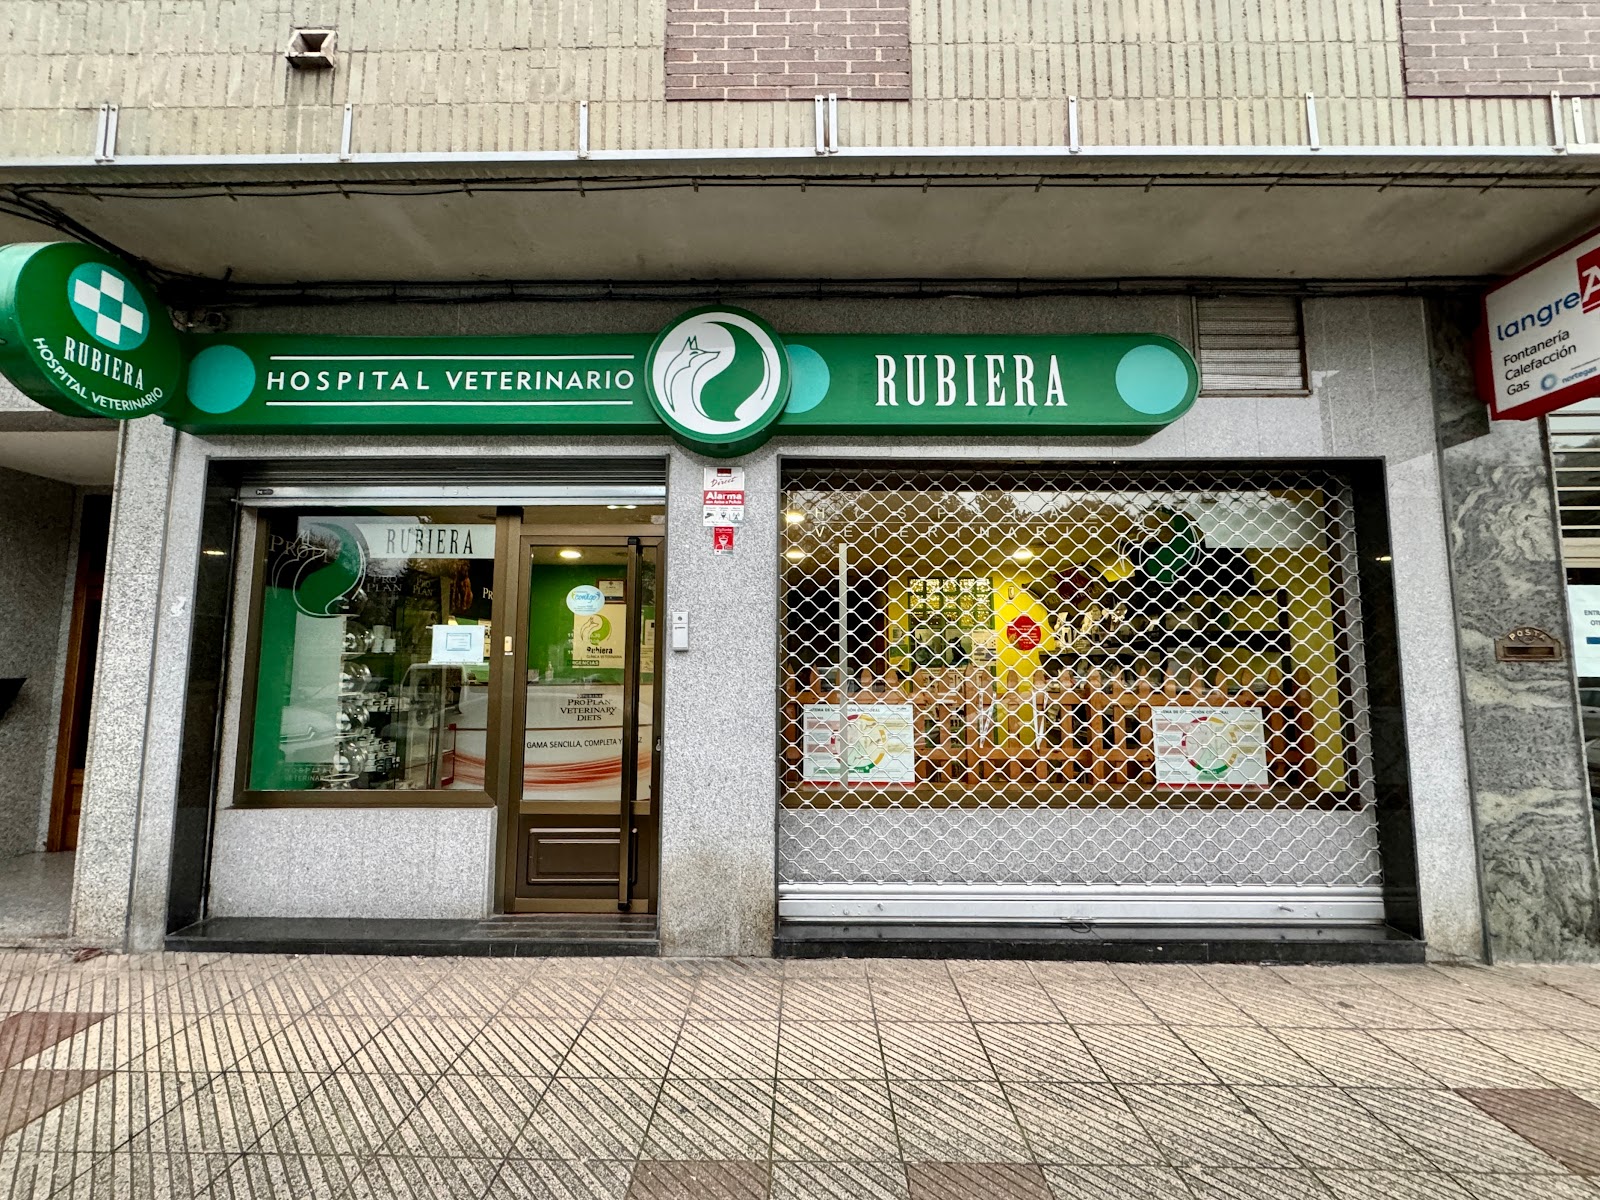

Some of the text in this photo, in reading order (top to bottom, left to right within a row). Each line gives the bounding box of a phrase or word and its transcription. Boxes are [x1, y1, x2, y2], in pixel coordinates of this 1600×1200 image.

[1497, 292, 1580, 341] langre
[1503, 329, 1571, 366] Fontanería
[63, 335, 145, 391] RUBIERA
[1504, 344, 1577, 381] Calefacción
[32, 336, 164, 412] HOSPITAL VETERINARIO
[266, 368, 635, 392] HOSPITAL VETERINARIO
[874, 353, 1069, 407] RUBIERA
[1561, 365, 1598, 384] nortegas
[1506, 379, 1531, 396] Gas
[706, 491, 742, 500] Alarma
[386, 528, 474, 556] RUBIERA
[365, 582, 402, 593] PLAN
[482, 586, 495, 600] PR
[560, 706, 617, 716] VETERINARY
[567, 698, 611, 706] PRO PLAN
[526, 741, 548, 749] GAMA
[549, 740, 583, 749] SENCILLA,
[584, 738, 616, 747] COMPLETA
